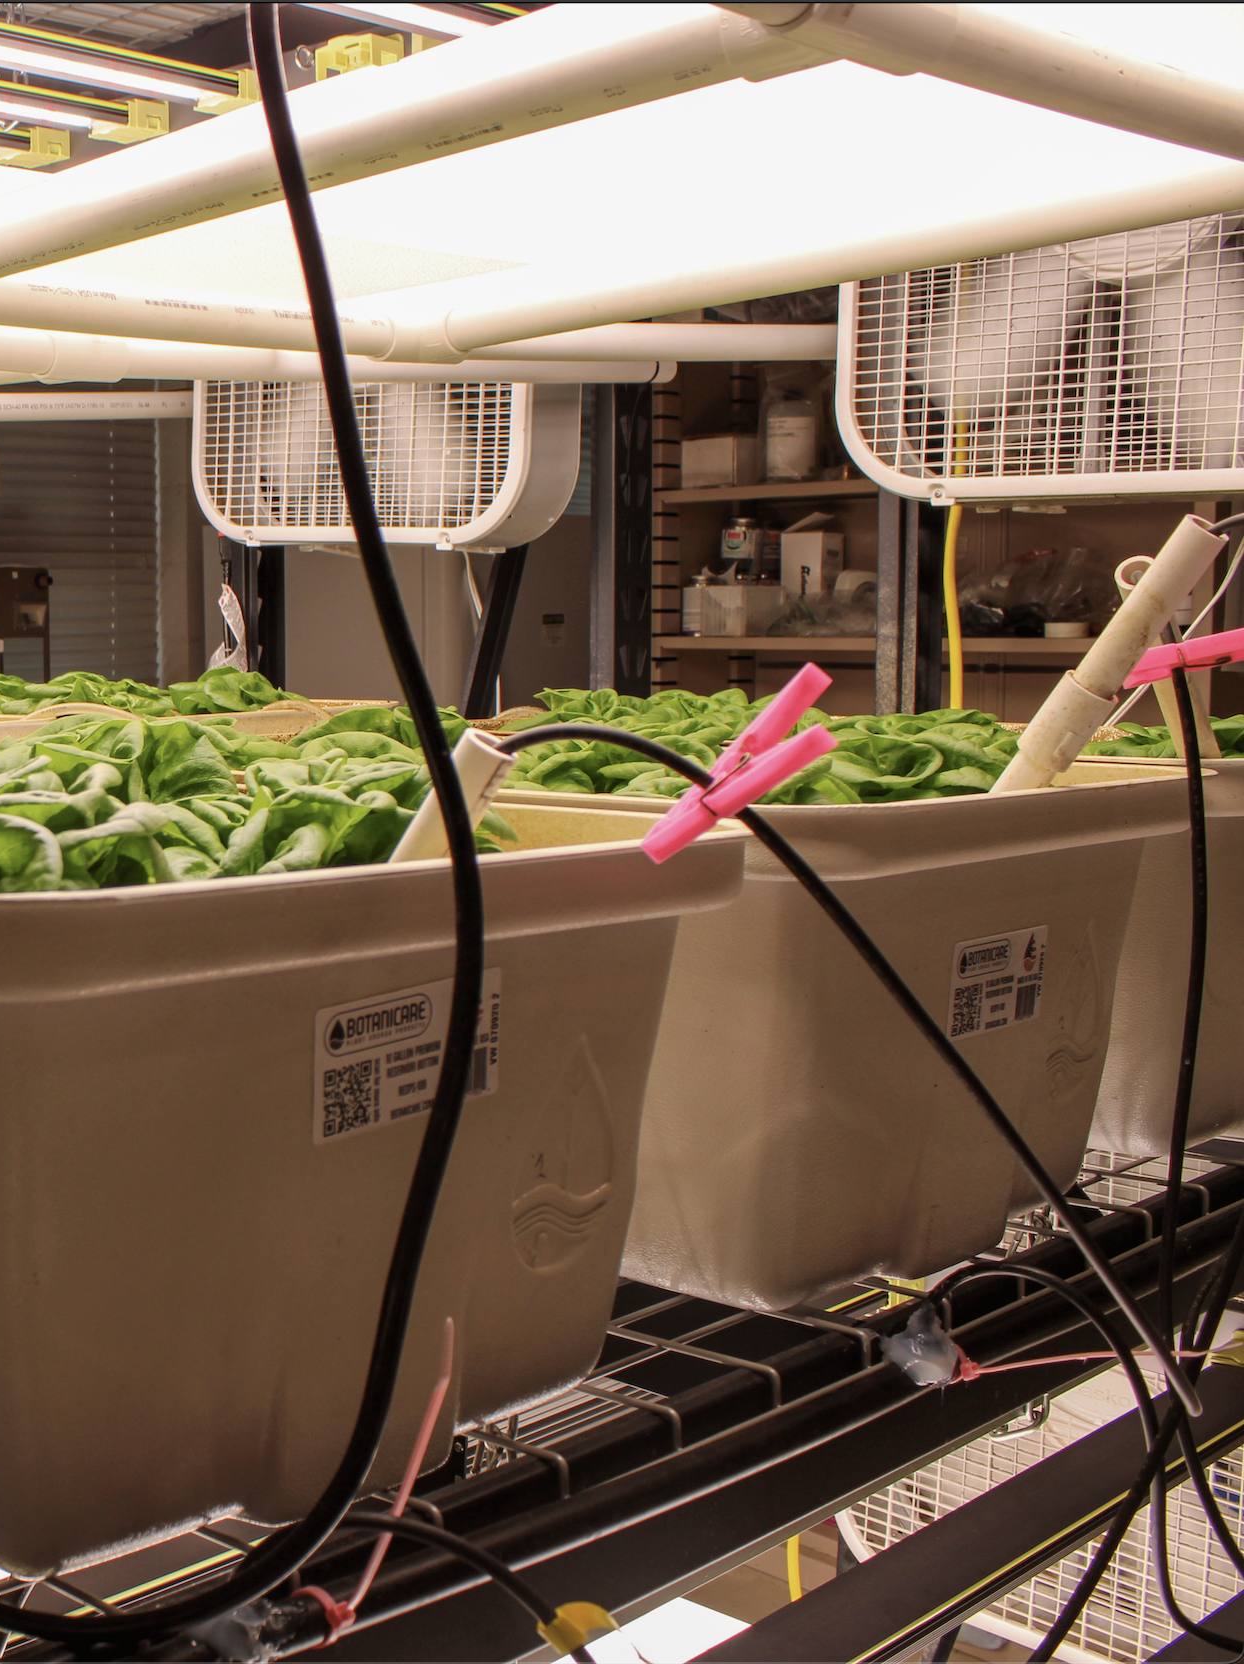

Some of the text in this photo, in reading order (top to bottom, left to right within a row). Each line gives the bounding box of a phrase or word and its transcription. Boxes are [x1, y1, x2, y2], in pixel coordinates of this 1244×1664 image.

[968, 944, 1009, 967] BOTANICARE
[346, 1000, 428, 1039] BOTANICARE
[490, 1002, 500, 1043] 070920
[393, 1048, 415, 1063] GALLON
[415, 1040, 442, 1057] PREMIUM
[489, 1047, 498, 1065] VW
